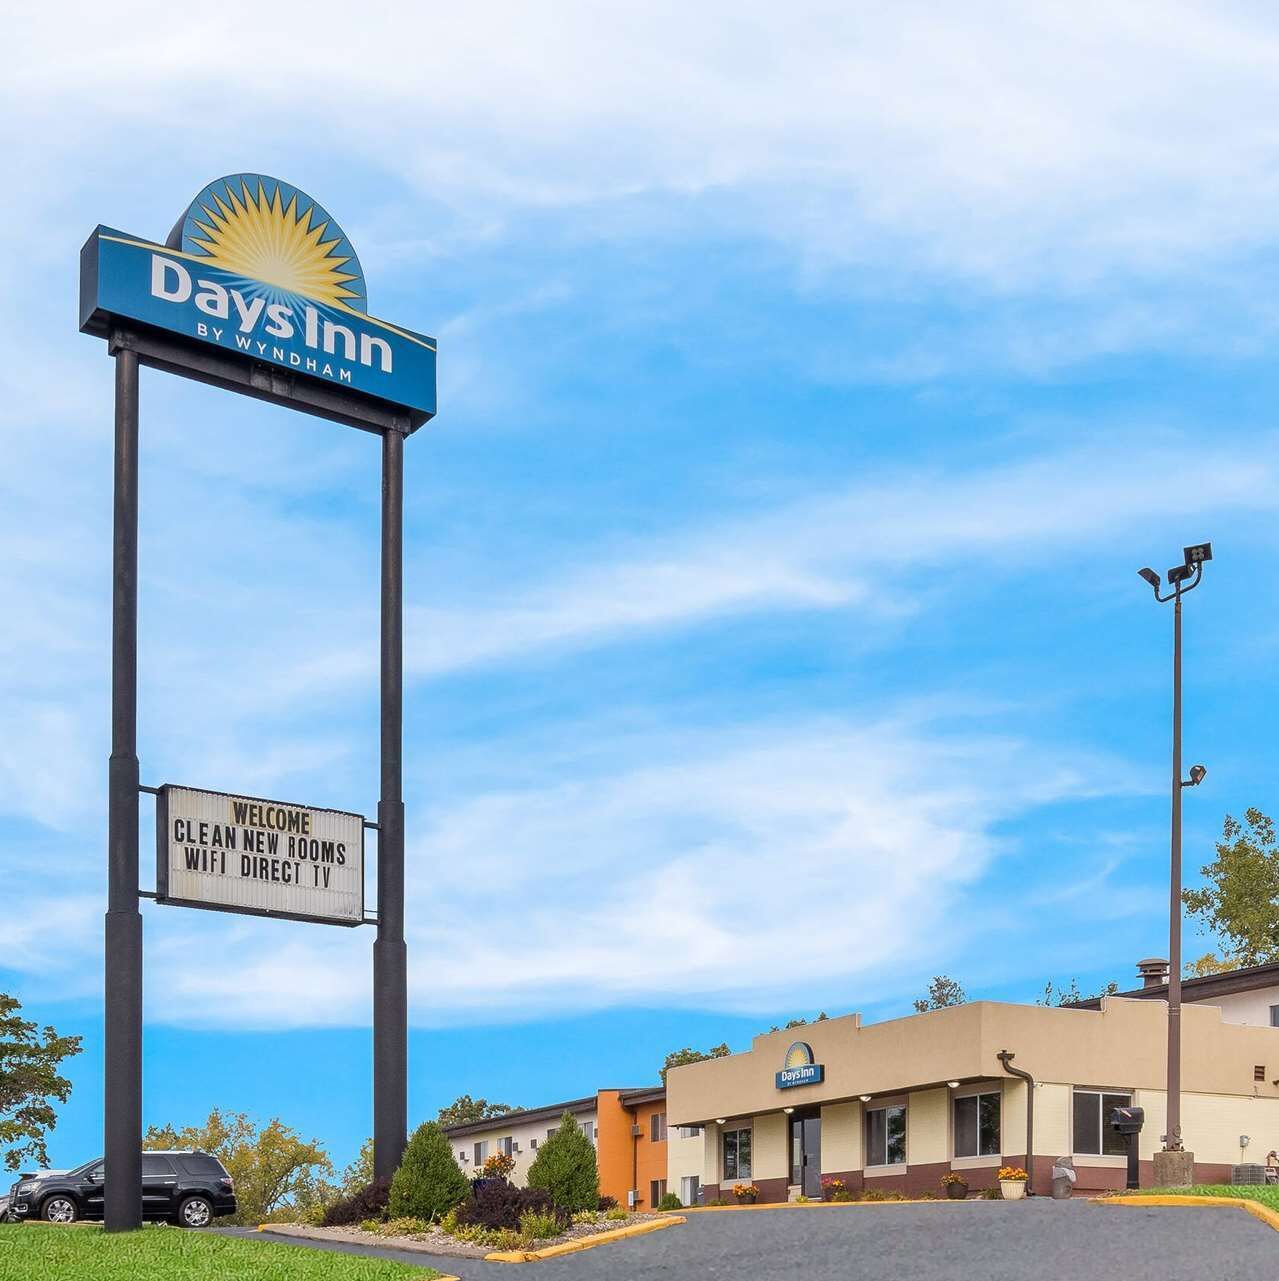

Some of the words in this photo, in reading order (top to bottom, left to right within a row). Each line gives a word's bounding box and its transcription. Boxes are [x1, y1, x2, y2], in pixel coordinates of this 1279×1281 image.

[151, 254, 295, 340] Days
[305, 307, 392, 374] Inn
[198, 322, 224, 342] BY
[235, 335, 352, 383] WYNDHAM
[174, 818, 236, 849] CLEAN
[243, 829, 279, 855] NEW
[288, 837, 346, 865] ROOMS
[233, 801, 310, 835] WELCOME
[184, 846, 226, 874] WIFI
[241, 855, 301, 884] DIRECT
[314, 865, 331, 888] TV
